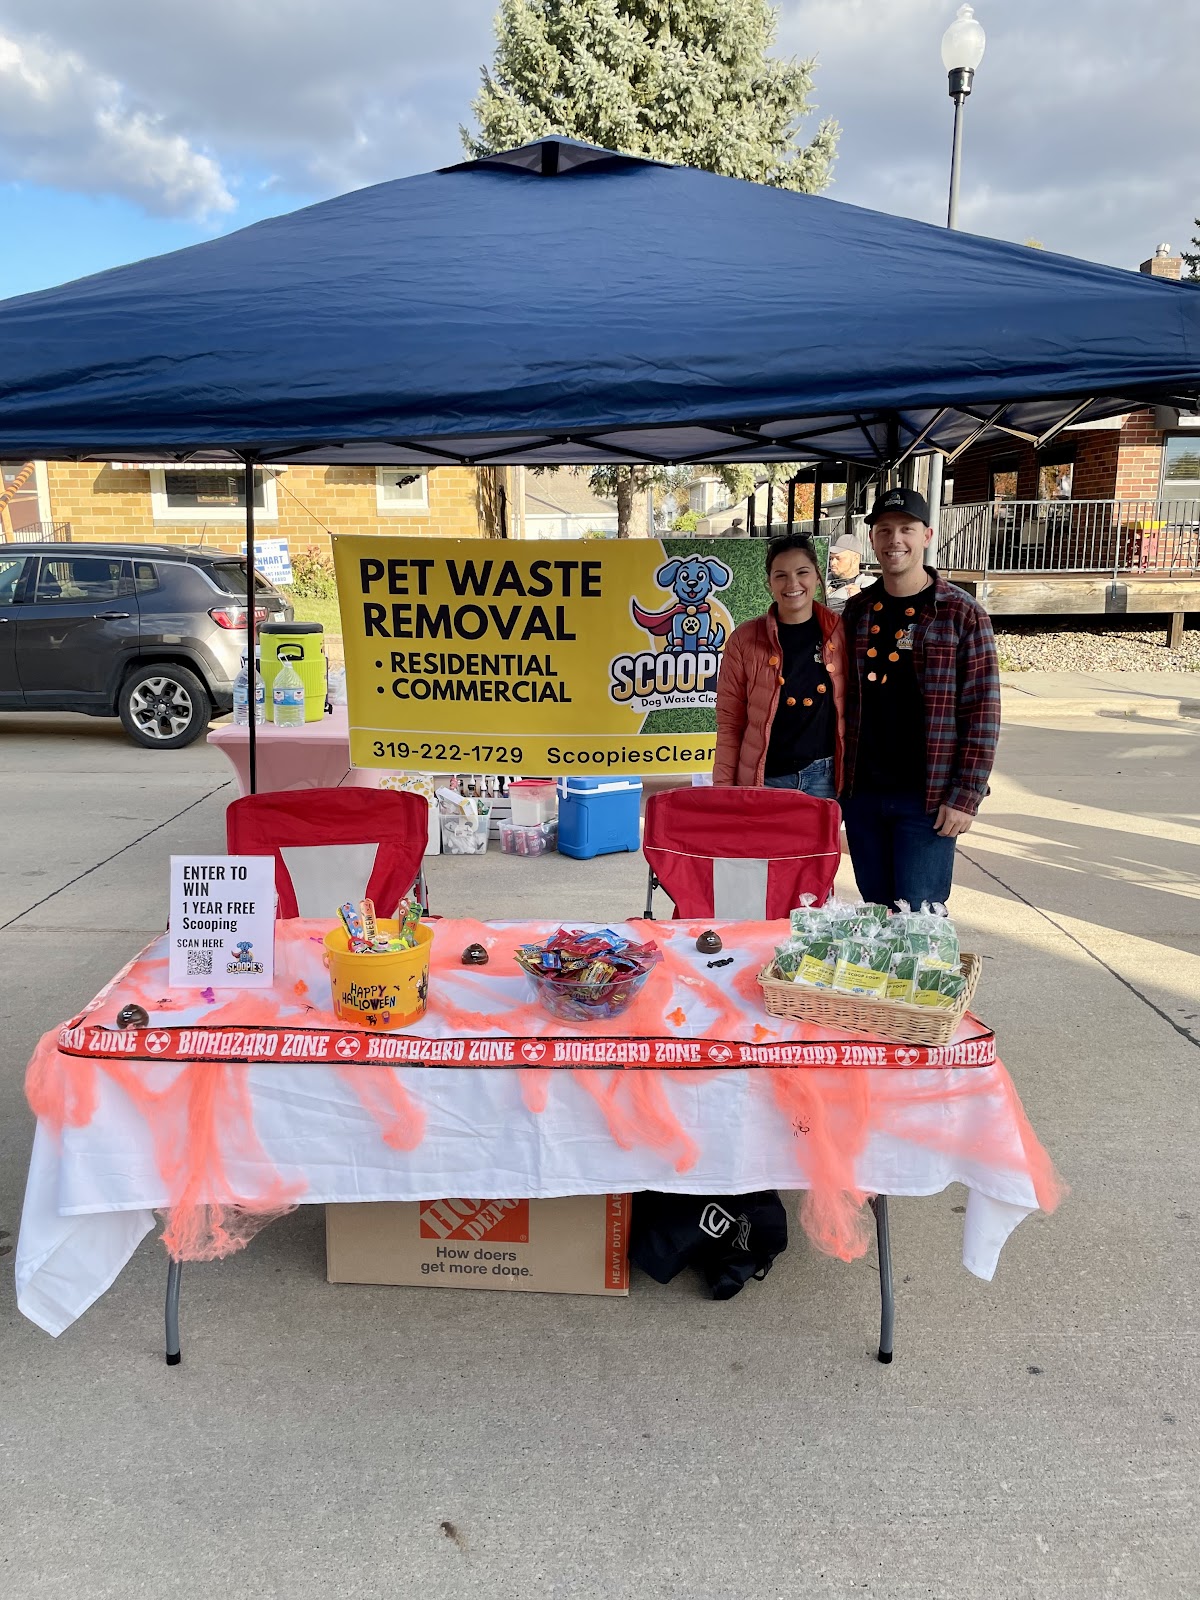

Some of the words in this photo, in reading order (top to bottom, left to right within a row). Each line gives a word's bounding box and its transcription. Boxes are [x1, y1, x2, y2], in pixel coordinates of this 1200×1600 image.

[359, 558, 435, 595] PET
[446, 559, 602, 597] WASTE
[364, 602, 576, 641] REMOVAL
[391, 652, 558, 677] RESIDENTIAL
[392, 678, 572, 703] COMMERCIAL
[641, 698, 662, 707] Dog
[663, 694, 696, 704] Waste
[373, 740, 524, 765] 319-222-1729
[183, 865, 226, 881] ENTER
[230, 866, 248, 881] TO
[183, 882, 209, 897] WIN
[182, 902, 188, 914] 1
[193, 902, 223, 915] YEAR
[227, 902, 255, 915] FREE
[182, 917, 238, 932] Scooping
[177, 938, 199, 948] SCAN
[201, 939, 224, 948] HERE
[227, 962, 263, 973] SCOOPIE'S
[342, 991, 396, 1011] HALLOWEEN
[350, 982, 387, 999] HAPPY
[88, 1030, 139, 1053] ZONE
[176, 1031, 278, 1057] BIOHAZARD
[280, 1034, 330, 1057] ZONE
[366, 1038, 464, 1061] BIOHAZARD
[468, 1041, 515, 1062] ZONE
[552, 1042, 651, 1063] BIOHAZARD
[655, 1042, 701, 1063] ZONE
[739, 1045, 838, 1065] BIOHAZARD
[841, 1045, 888, 1066] ZONE
[613, 1221, 622, 1248] DUTY
[436, 1247, 470, 1259] How
[474, 1249, 517, 1261] doers
[421, 1262, 446, 1275] get
[449, 1264, 488, 1275] more
[612, 1251, 621, 1284] HEAVY
